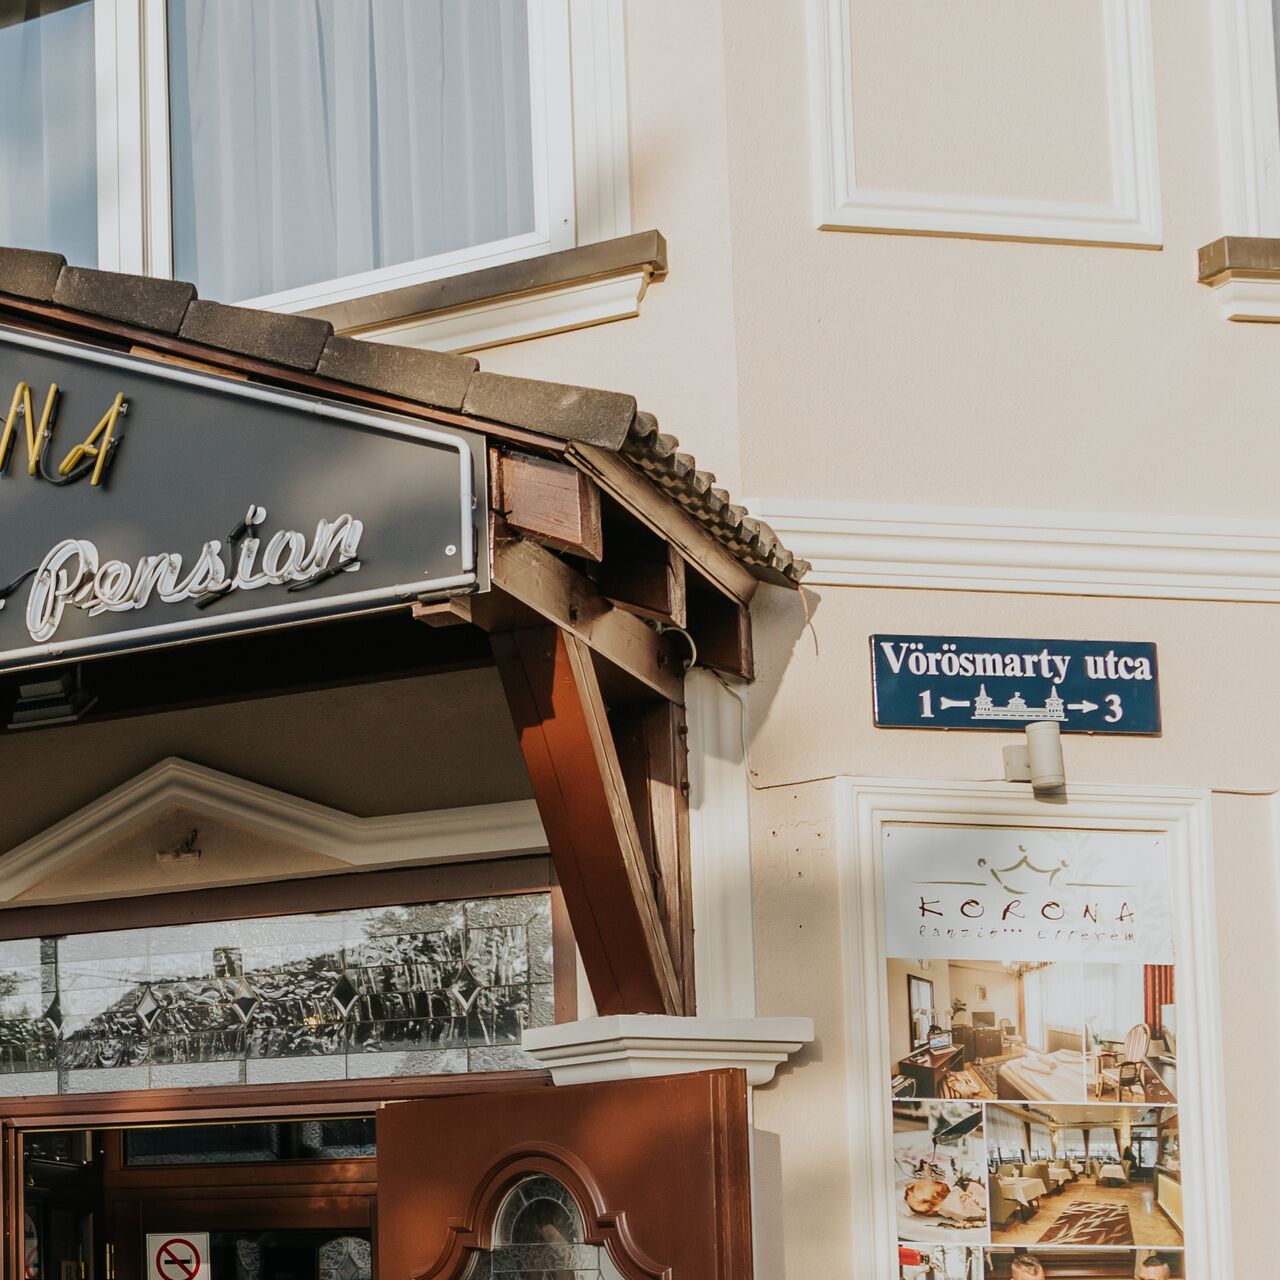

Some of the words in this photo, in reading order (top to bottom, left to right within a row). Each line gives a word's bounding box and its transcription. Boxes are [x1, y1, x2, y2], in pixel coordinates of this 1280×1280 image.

[25, 504, 364, 642] Pension
[879, 641, 1071, 685] Vörösmarty
[1085, 650, 1153, 682] utca
[918, 689, 934, 718] 1
[1104, 694, 1123, 723] 3
[919, 896, 1135, 923] KORONA
